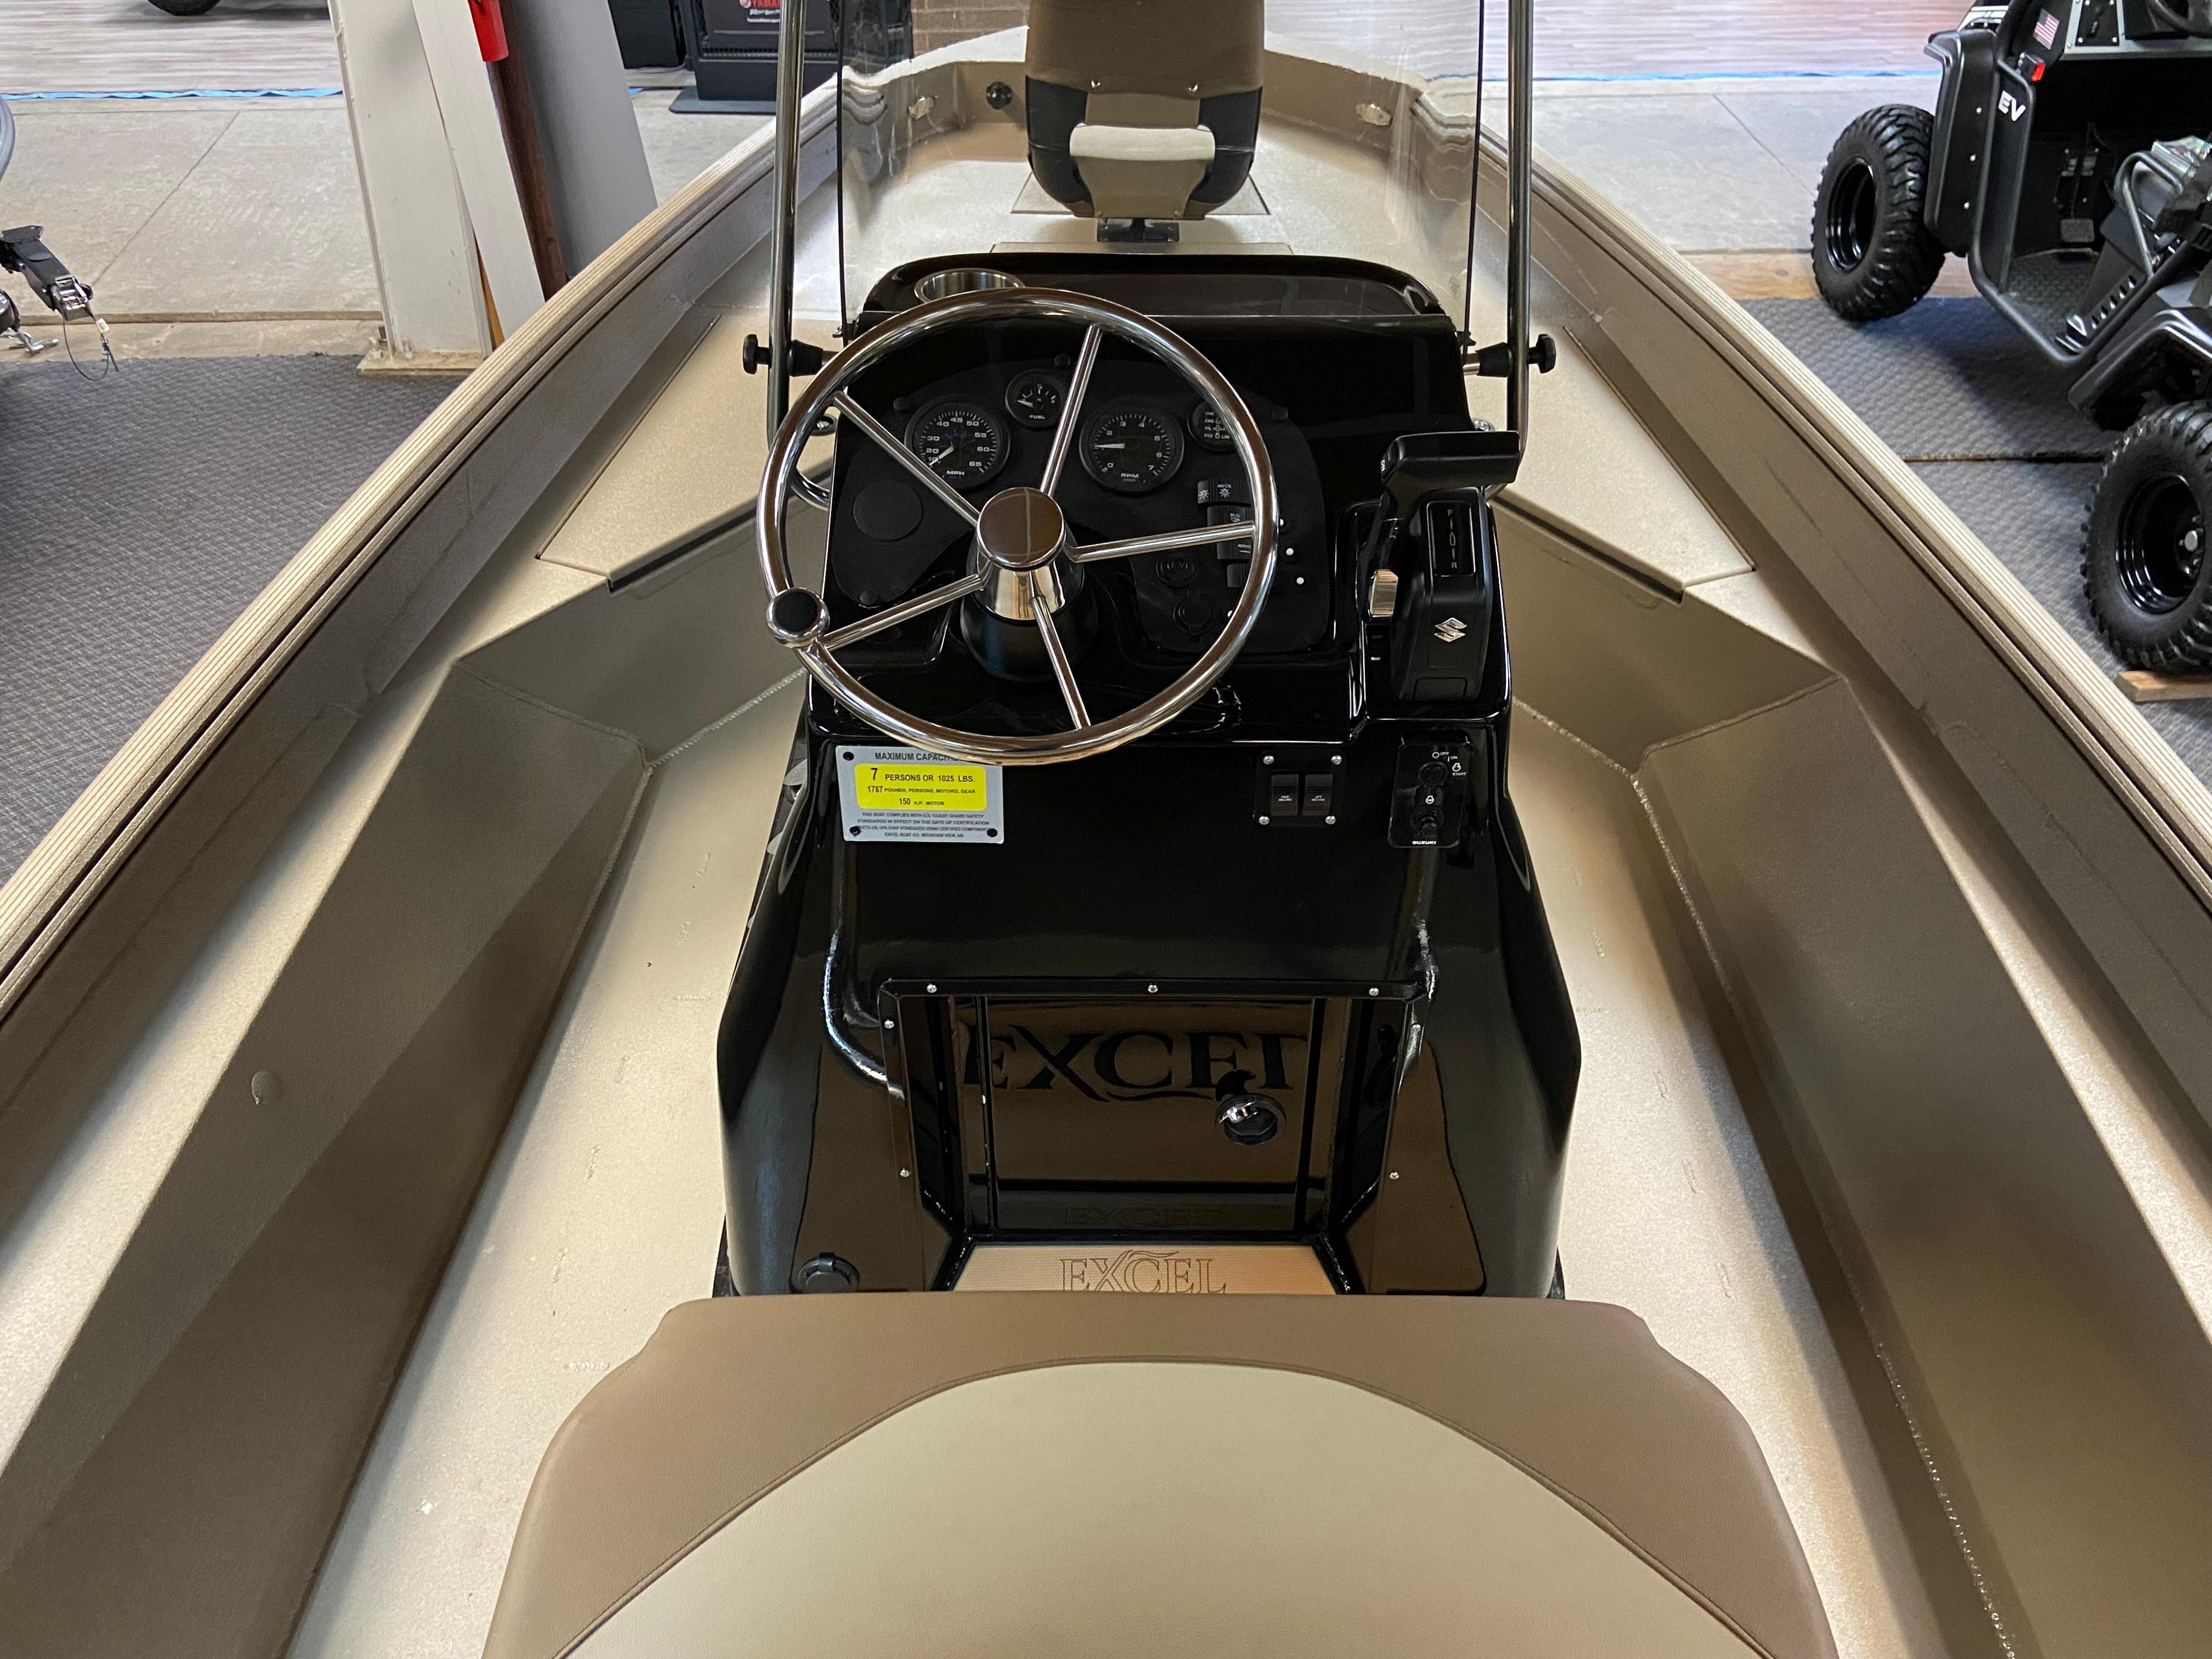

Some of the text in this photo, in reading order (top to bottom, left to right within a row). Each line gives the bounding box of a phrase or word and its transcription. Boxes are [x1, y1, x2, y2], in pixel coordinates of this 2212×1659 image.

[1999, 91, 2026, 122] EV
[875, 752, 914, 760] MAXIMUM
[871, 768, 878, 780] 7
[1060, 1250, 1226, 1295] EXCEL
